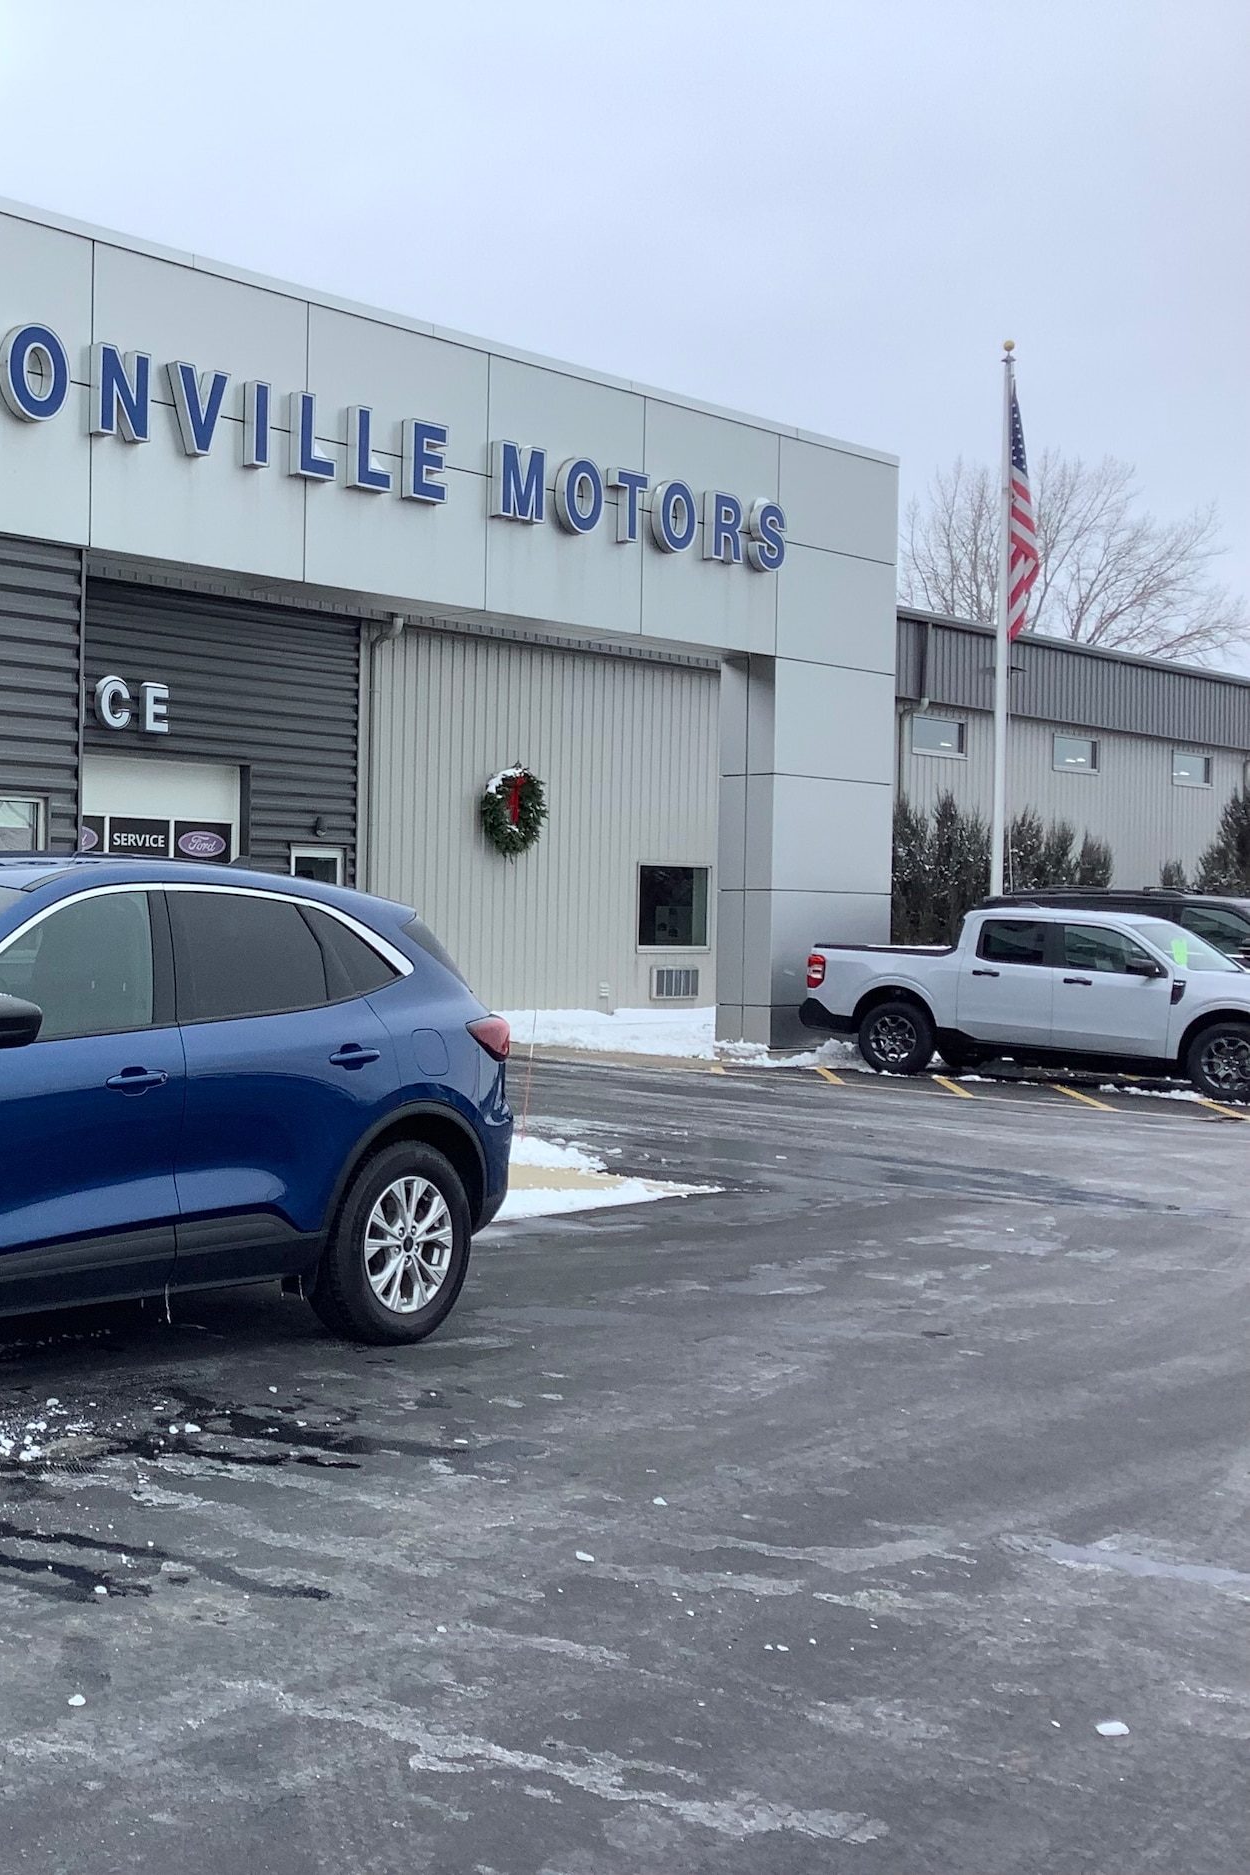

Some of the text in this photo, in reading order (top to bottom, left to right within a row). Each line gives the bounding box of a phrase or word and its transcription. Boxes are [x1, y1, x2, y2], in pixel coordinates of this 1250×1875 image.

[490, 439, 788, 573] MOTORS
[112, 832, 166, 848] SERVICE
[187, 834, 218, 853] Ford
